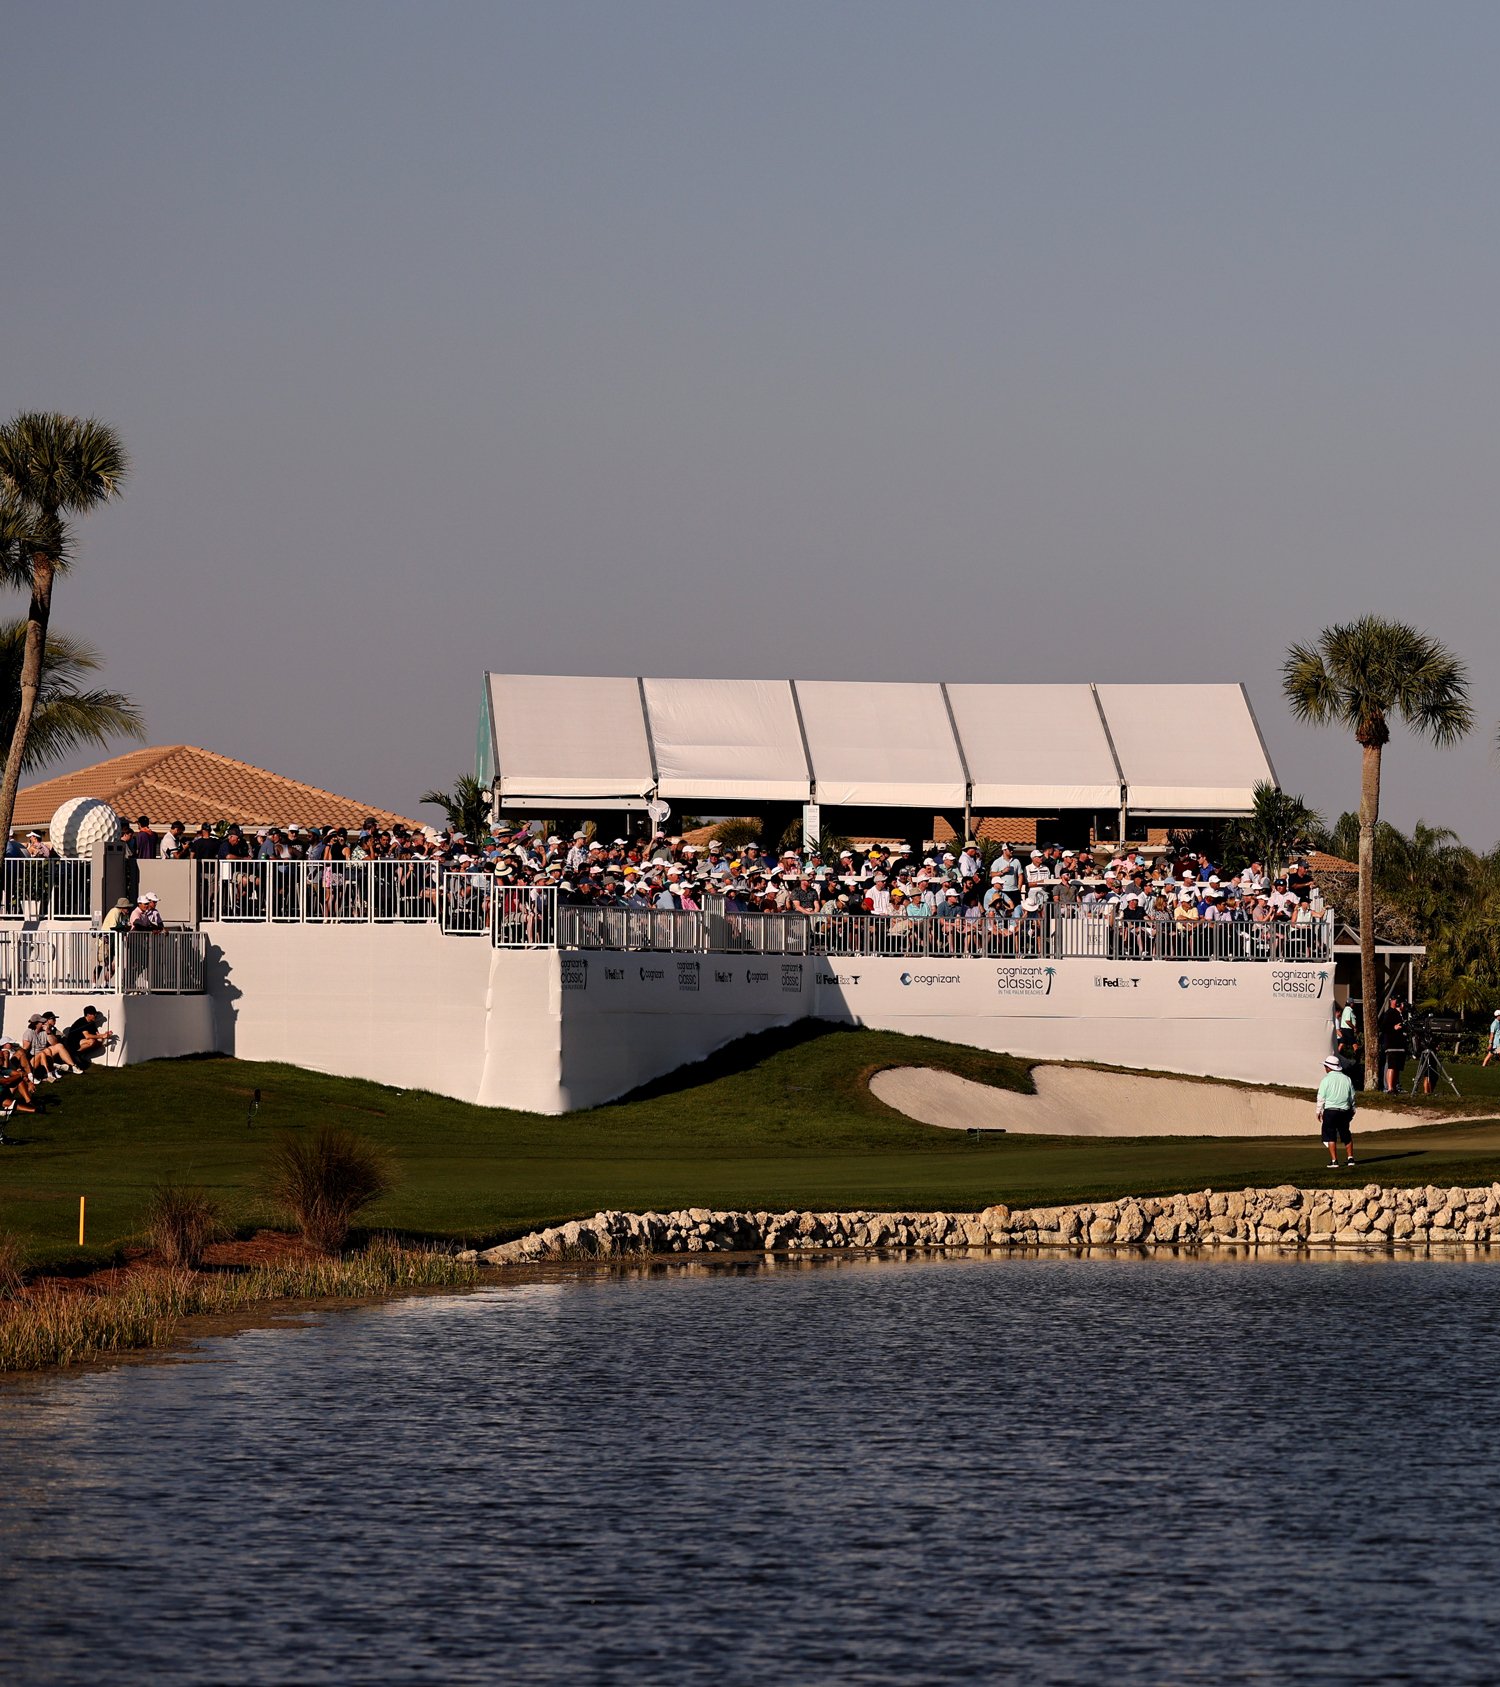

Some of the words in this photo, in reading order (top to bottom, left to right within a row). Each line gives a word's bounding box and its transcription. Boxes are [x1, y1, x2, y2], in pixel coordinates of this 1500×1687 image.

[561, 968, 584, 983] classic
[997, 966, 1042, 977] cognizant
[1272, 970, 1316, 981] cognizant
[823, 974, 850, 985] FedEx
[914, 974, 961, 985] cognizant
[998, 976, 1043, 989] classic
[1103, 977, 1130, 988] FedEx
[1192, 977, 1237, 988] cognizant
[1273, 980, 1316, 993] classic
